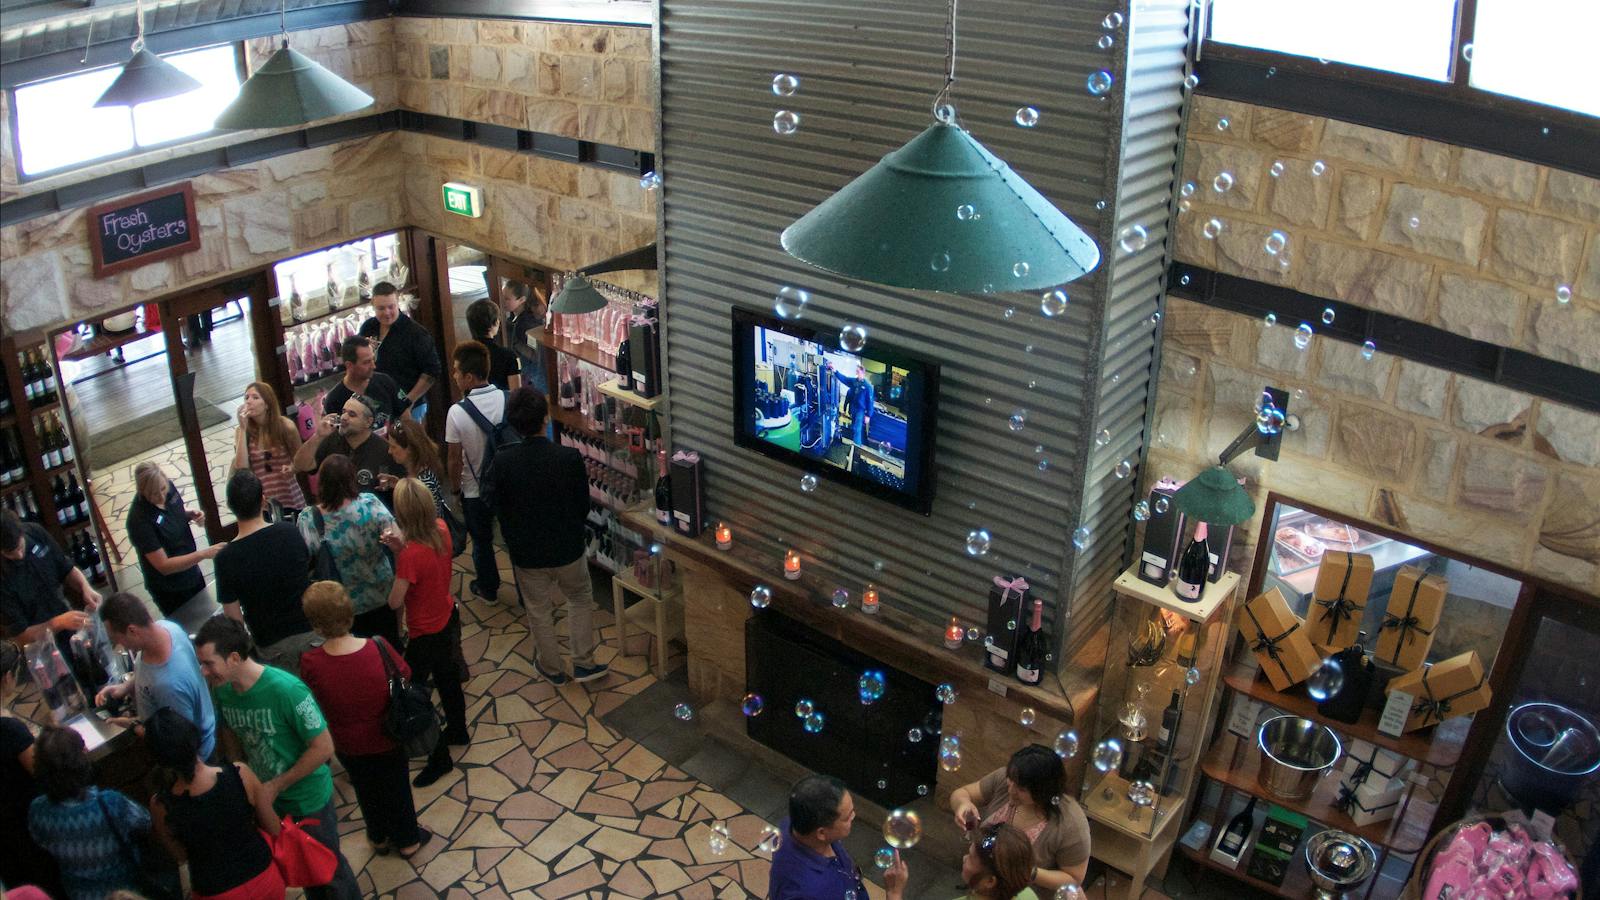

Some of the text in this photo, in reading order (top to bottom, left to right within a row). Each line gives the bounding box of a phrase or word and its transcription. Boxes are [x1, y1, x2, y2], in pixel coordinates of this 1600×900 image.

[448, 191, 467, 211] EXIT
[102, 208, 148, 236] Fresh
[117, 219, 187, 254] Oysters
